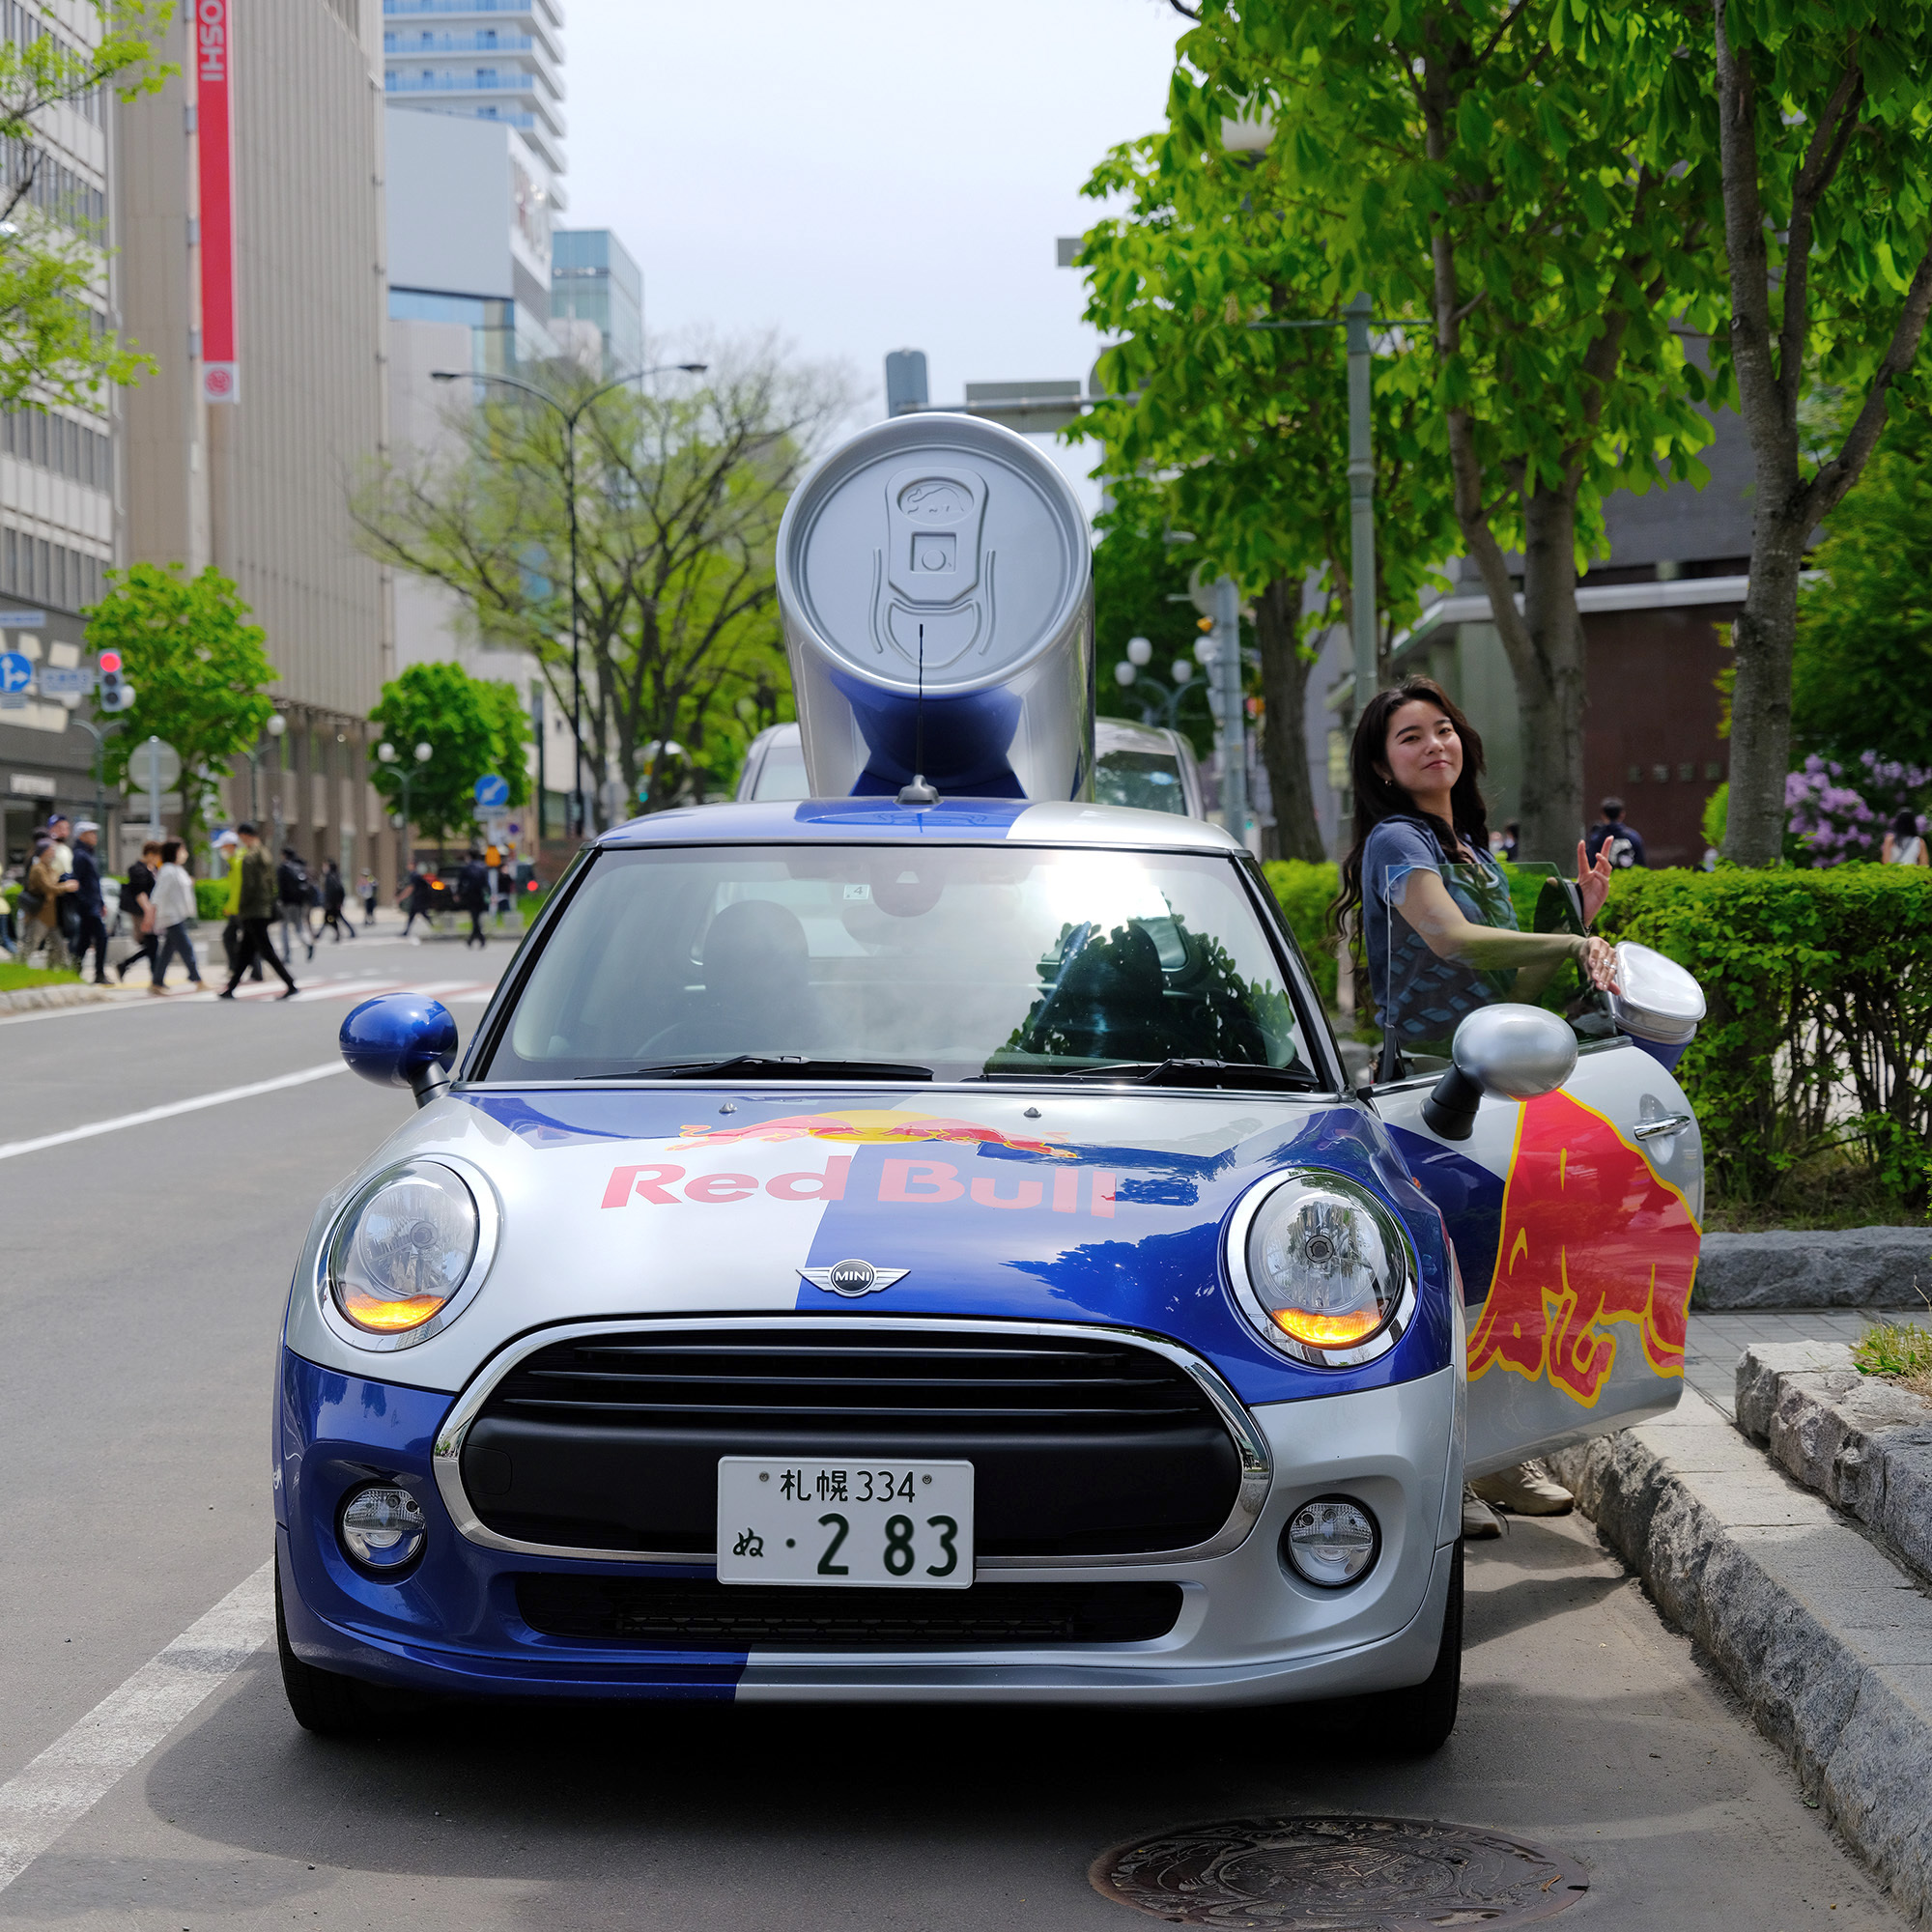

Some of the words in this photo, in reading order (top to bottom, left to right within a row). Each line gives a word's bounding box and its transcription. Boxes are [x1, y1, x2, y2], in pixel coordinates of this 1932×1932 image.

[853, 886, 864, 895] 4
[601, 1155, 852, 1209] Red
[877, 1158, 1117, 1219] Bull
[835, 1270, 870, 1282] MINI
